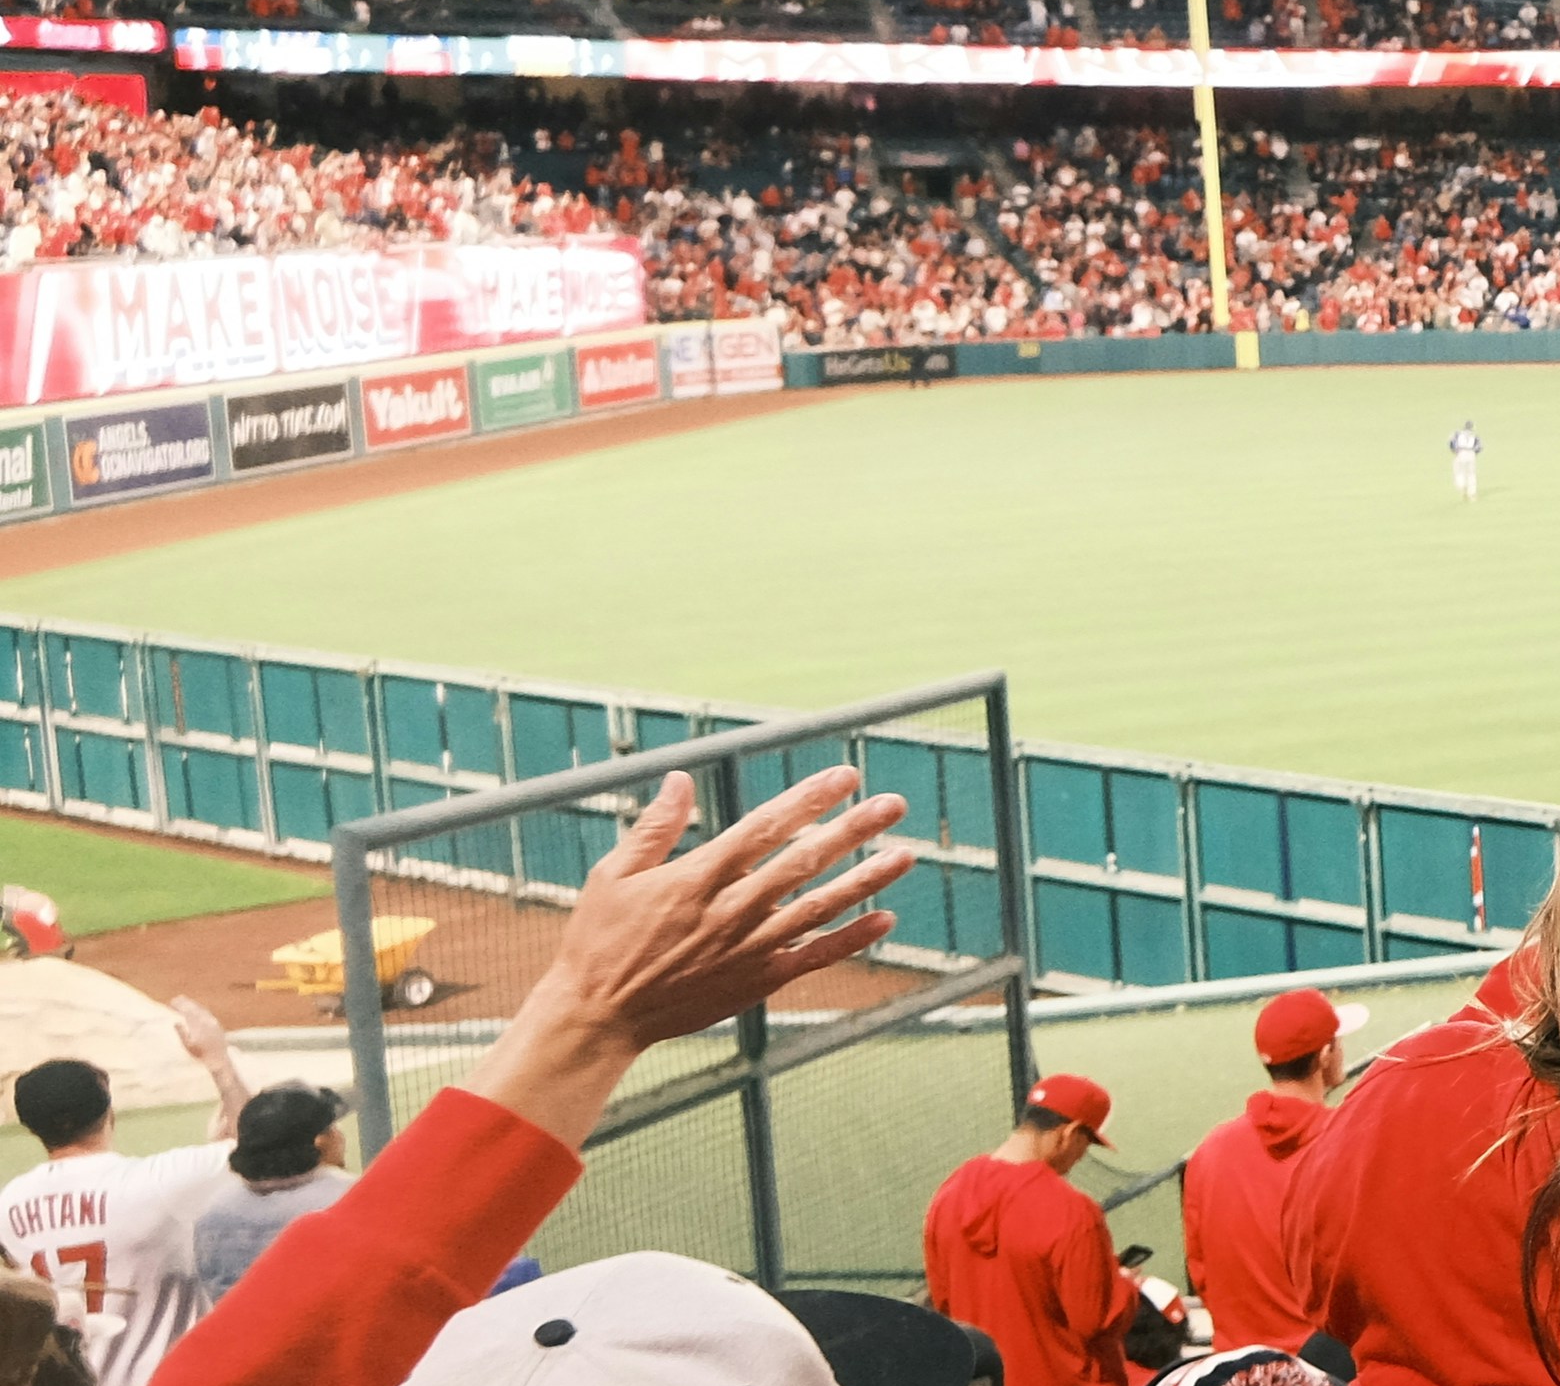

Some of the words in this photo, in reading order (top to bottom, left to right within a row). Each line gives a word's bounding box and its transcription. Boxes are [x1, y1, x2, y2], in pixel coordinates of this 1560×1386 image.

[108, 268, 267, 358] MAKE
[279, 257, 404, 351] NOISE
[367, 377, 464, 431] Yakult
[8, 1189, 108, 1239] OHTANI
